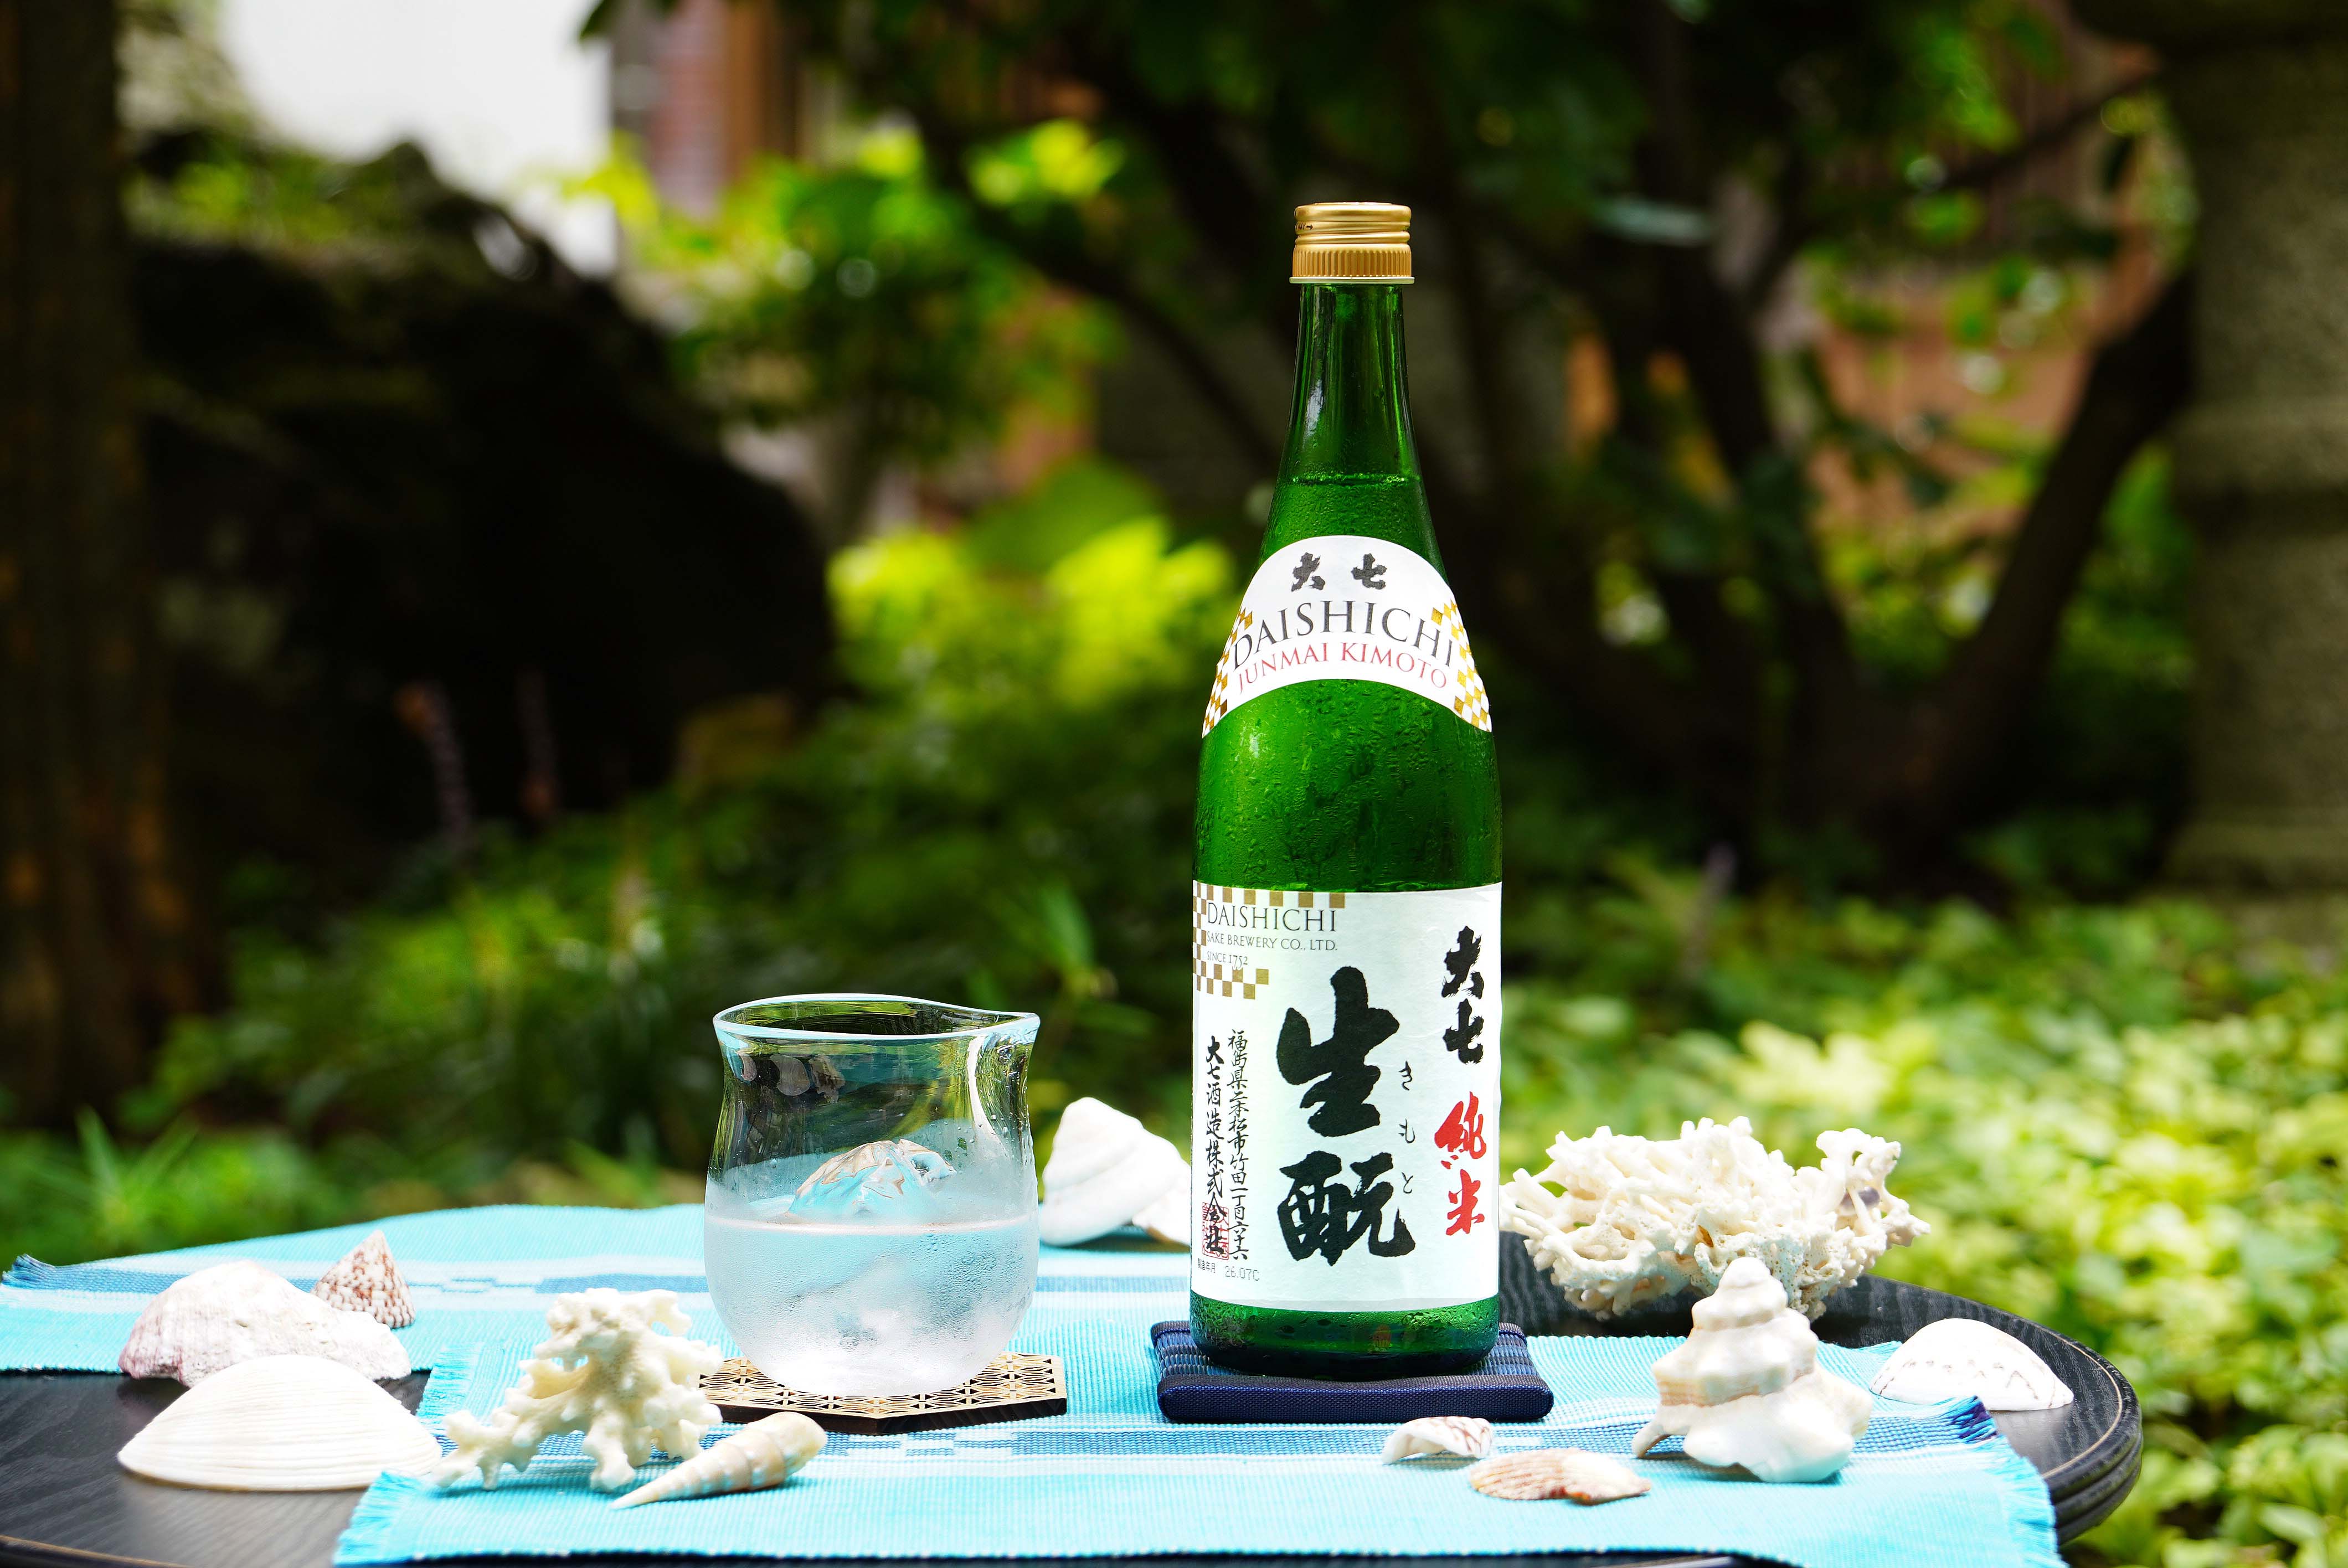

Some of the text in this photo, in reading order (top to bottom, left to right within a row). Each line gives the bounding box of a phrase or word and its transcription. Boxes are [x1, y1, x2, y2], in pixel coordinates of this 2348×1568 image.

[1233, 600, 1454, 670] DAISHICHI
[1238, 642, 1448, 695] JUNMAI KIMOTO
[1207, 902, 1337, 932] DAISHICHI
[1207, 931, 1338, 951] SAKE BREWERY CO., LTD.
[1207, 951, 1248, 969] SINCE 1752
[1441, 925, 1485, 1065] 大七
[1398, 1060, 1416, 1194] きもと
[1434, 1091, 1487, 1236] 純米
